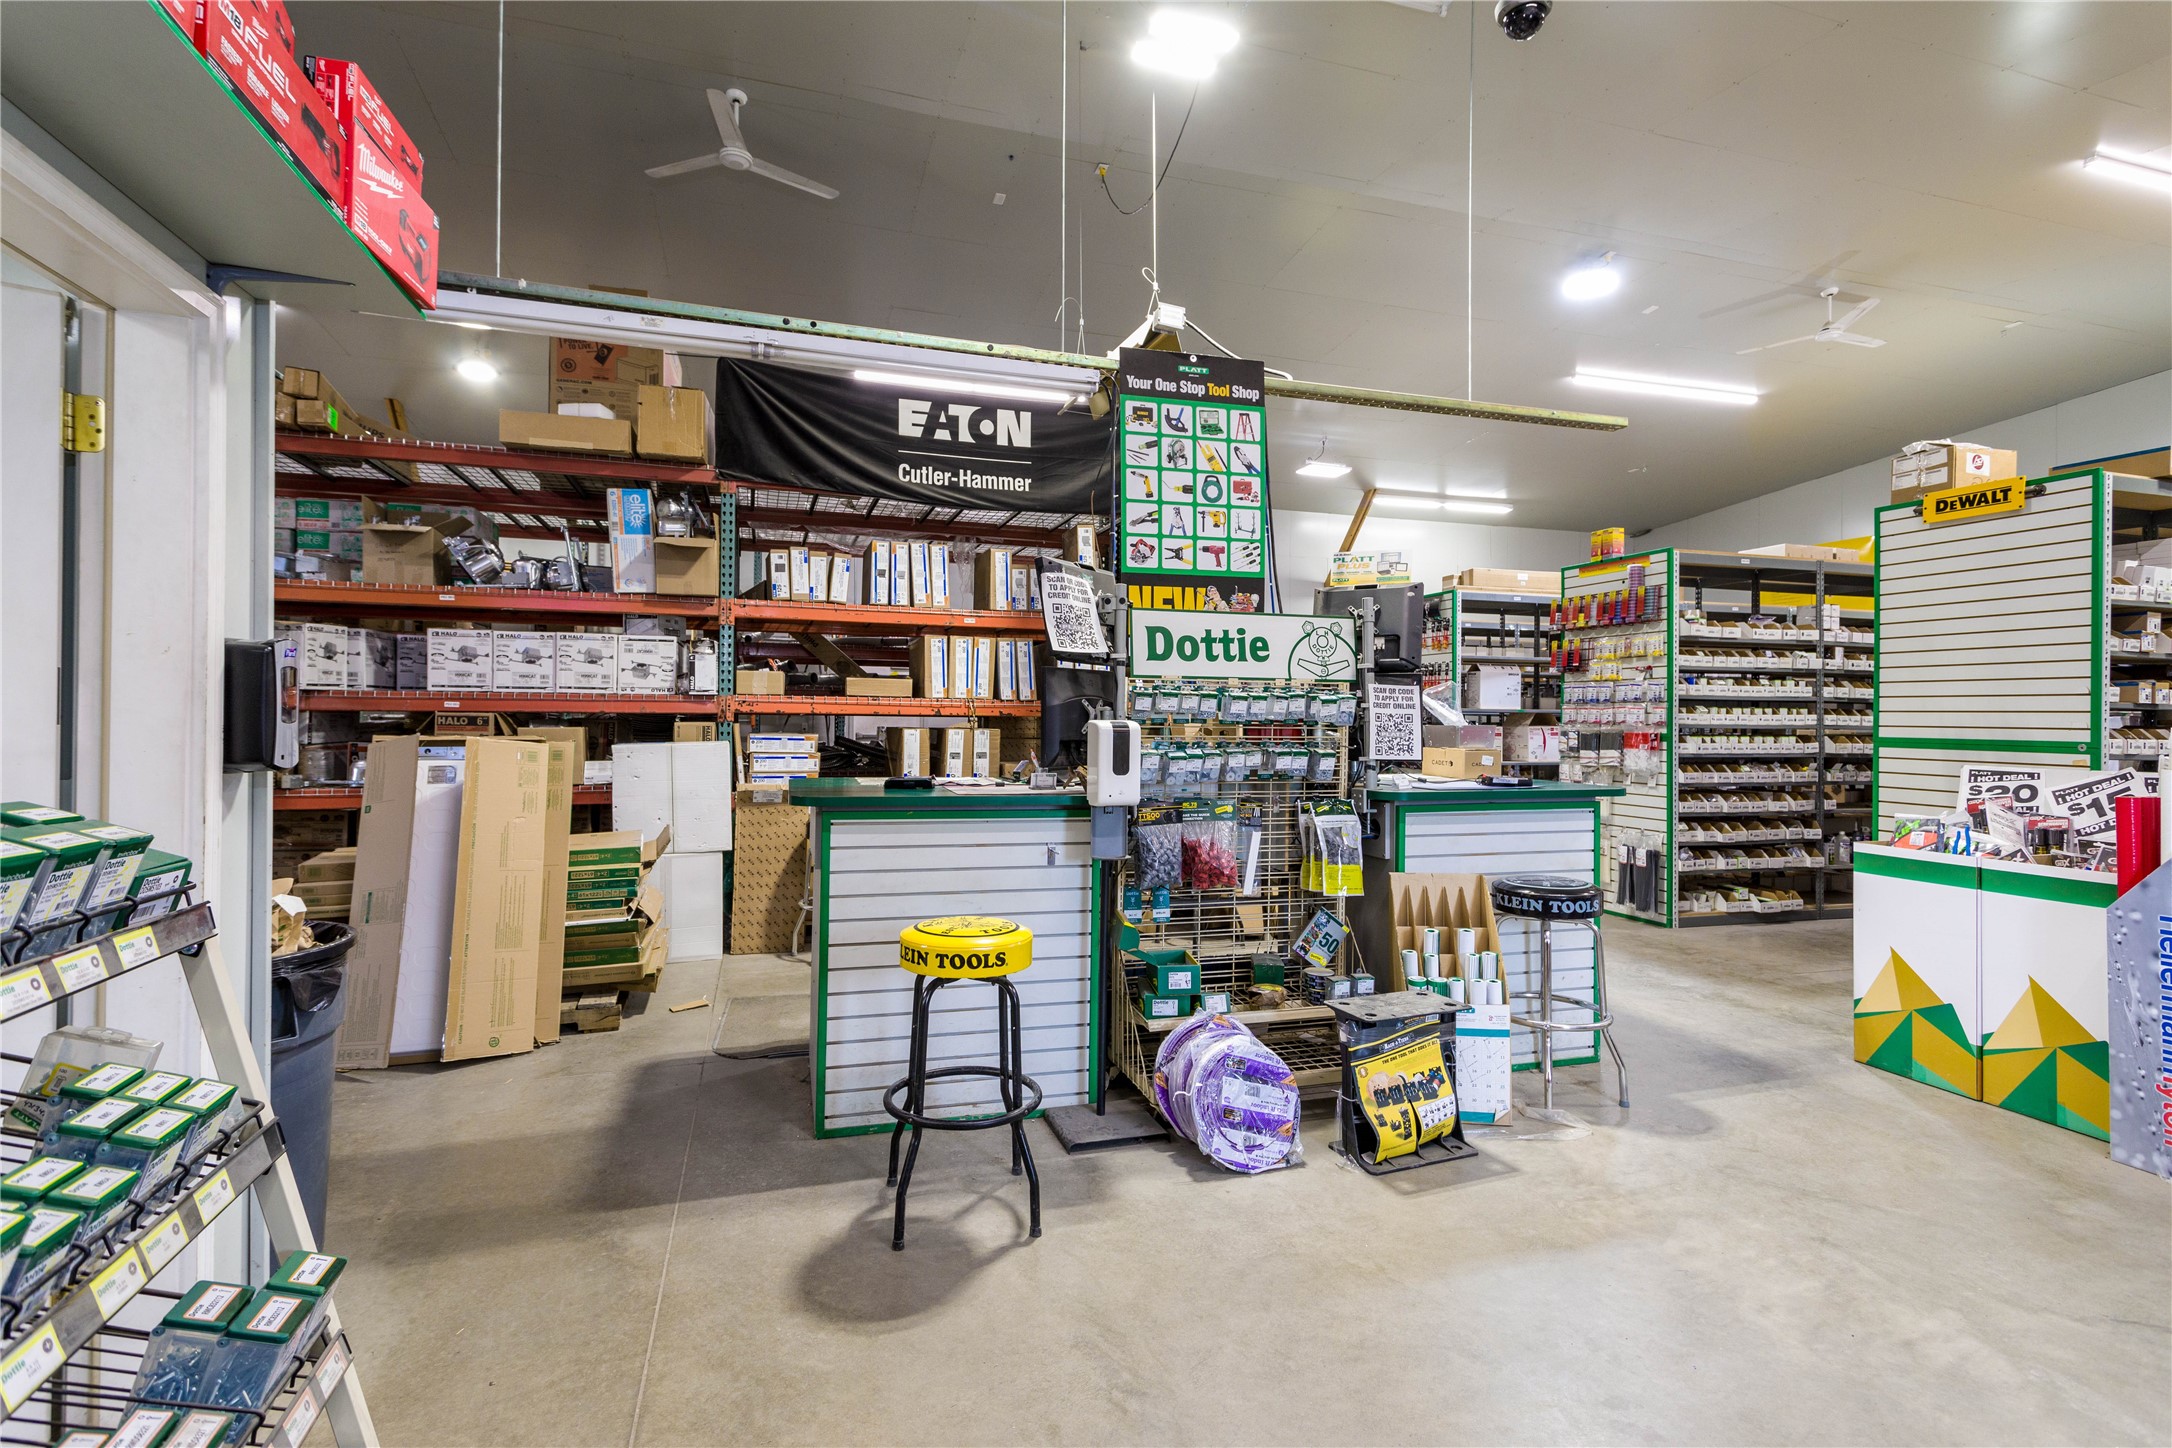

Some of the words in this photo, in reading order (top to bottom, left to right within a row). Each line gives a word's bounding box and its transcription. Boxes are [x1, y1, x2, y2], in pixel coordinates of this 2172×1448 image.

[244, 25, 297, 105] FUEL
[357, 143, 405, 193] Milwaukee
[1179, 366, 1208, 374] PLATT
[1126, 374, 1153, 390] Your
[1155, 377, 1178, 393] One
[1180, 380, 1206, 398] Stop
[1207, 382, 1231, 397] Tool
[1231, 384, 1261, 403] Shop
[898, 398, 1032, 448] EATON
[898, 463, 1032, 492] Cutler-Hammer
[1333, 555, 1375, 564] PLATT
[1336, 562, 1371, 570] PLUS
[1046, 575, 1066, 584] SCAN
[1059, 585, 1076, 594] APPLY
[1077, 588, 1089, 596] FOR
[1047, 592, 1072, 600] CREDIT
[1072, 594, 1092, 604] ONLINE
[1145, 625, 1270, 663] Dottie
[1311, 643, 1335, 655] DOTTIE
[1373, 687, 1387, 695] SCAN
[1397, 688, 1415, 696] CODE
[437, 716, 469, 726] HALO
[1977, 774, 2001, 783] HOT
[2002, 773, 2032, 782] DEAL
[2055, 787, 2080, 796] PLATT
[2065, 787, 2091, 803] HOT
[2093, 776, 2127, 794] DEAL
[2080, 822, 2107, 836] HOT
[104, 859, 127, 871] Dottie
[49, 870, 74, 884] Dottie
[1496, 893, 1543, 912] KLEIN
[1549, 899, 1600, 914] TOOLS
[119, 942, 135, 952] Dottie
[1318, 931, 1340, 954] 50
[935, 951, 1007, 970] TOOLS
[60, 962, 79, 974] Dottie
[1398, 1052, 1408, 1061] TOOL
[1408, 1048, 1417, 1057] THAT
[146, 1237, 162, 1255] Dottie
[96, 1278, 116, 1298] Dottie
[188, 1303, 205, 1318] Dottie
[253, 1315, 267, 1329] Dottie
[0, 1358, 27, 1384] Dottie
